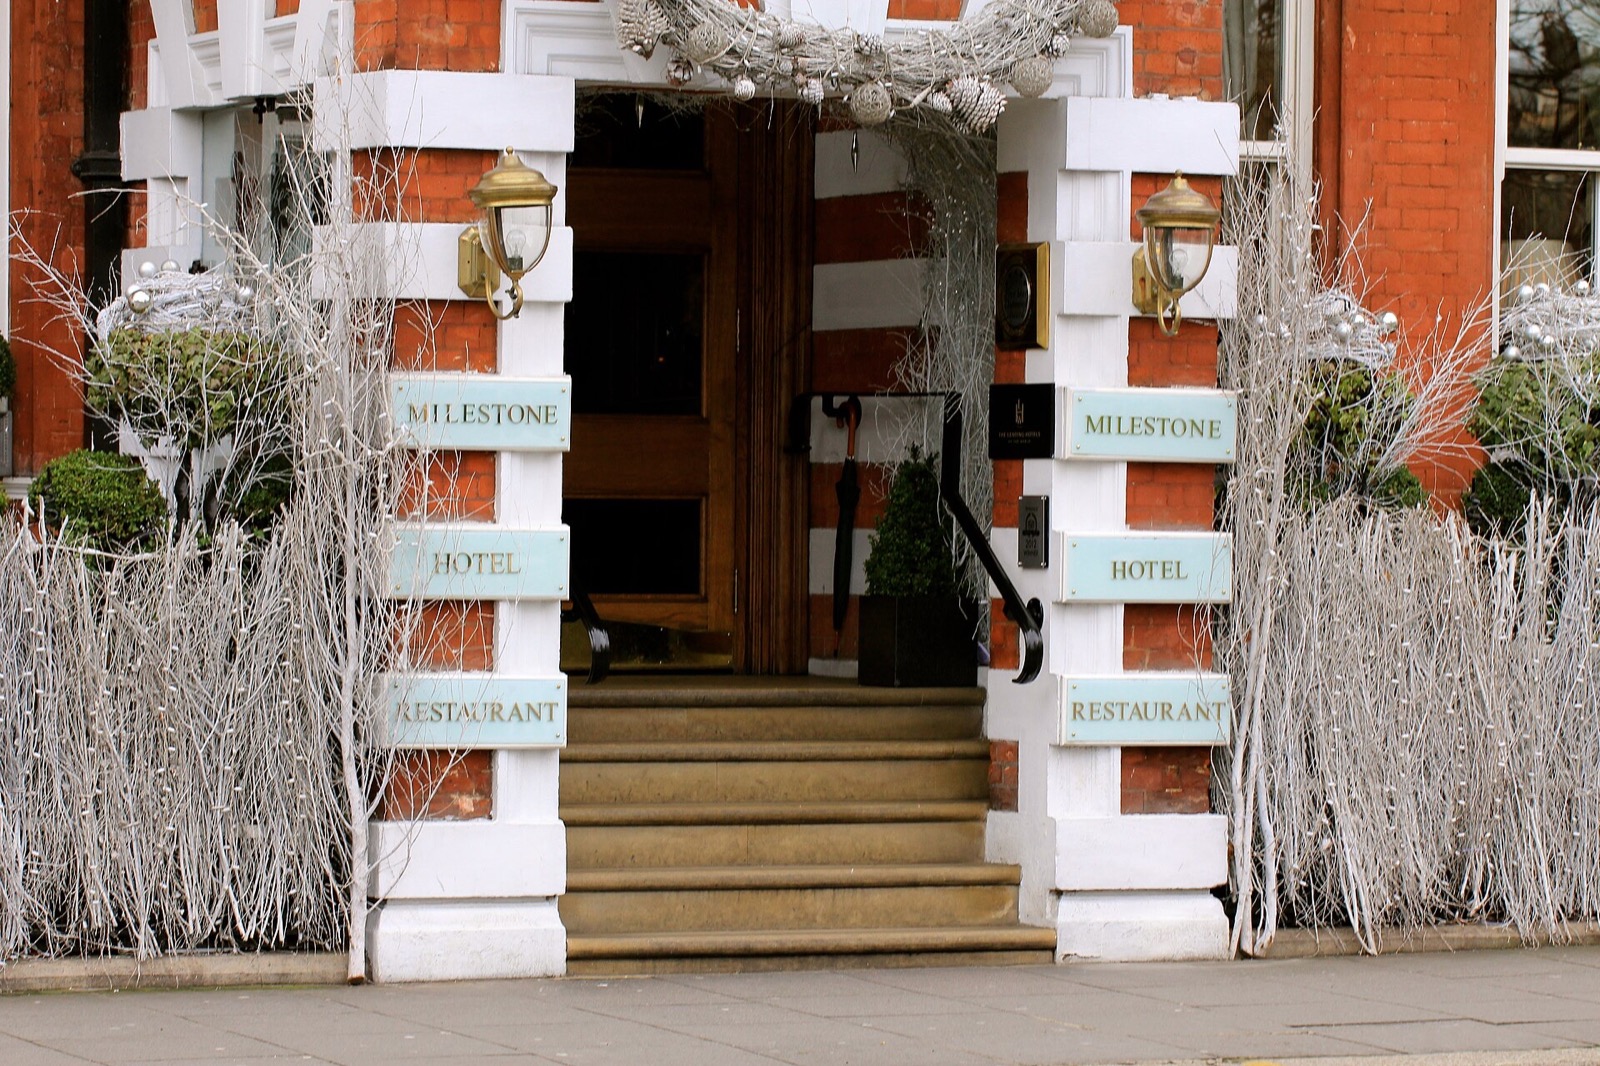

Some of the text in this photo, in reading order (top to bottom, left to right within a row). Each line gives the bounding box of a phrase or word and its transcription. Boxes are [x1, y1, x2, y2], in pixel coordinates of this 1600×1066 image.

[408, 403, 558, 425] MILESTONE
[1085, 414, 1222, 439] MILESTONE
[433, 552, 521, 574] HOTEL
[1110, 560, 1188, 580] HOTEL
[395, 701, 559, 722] RESTAURANT
[1071, 701, 1226, 721] RESTAURANT
